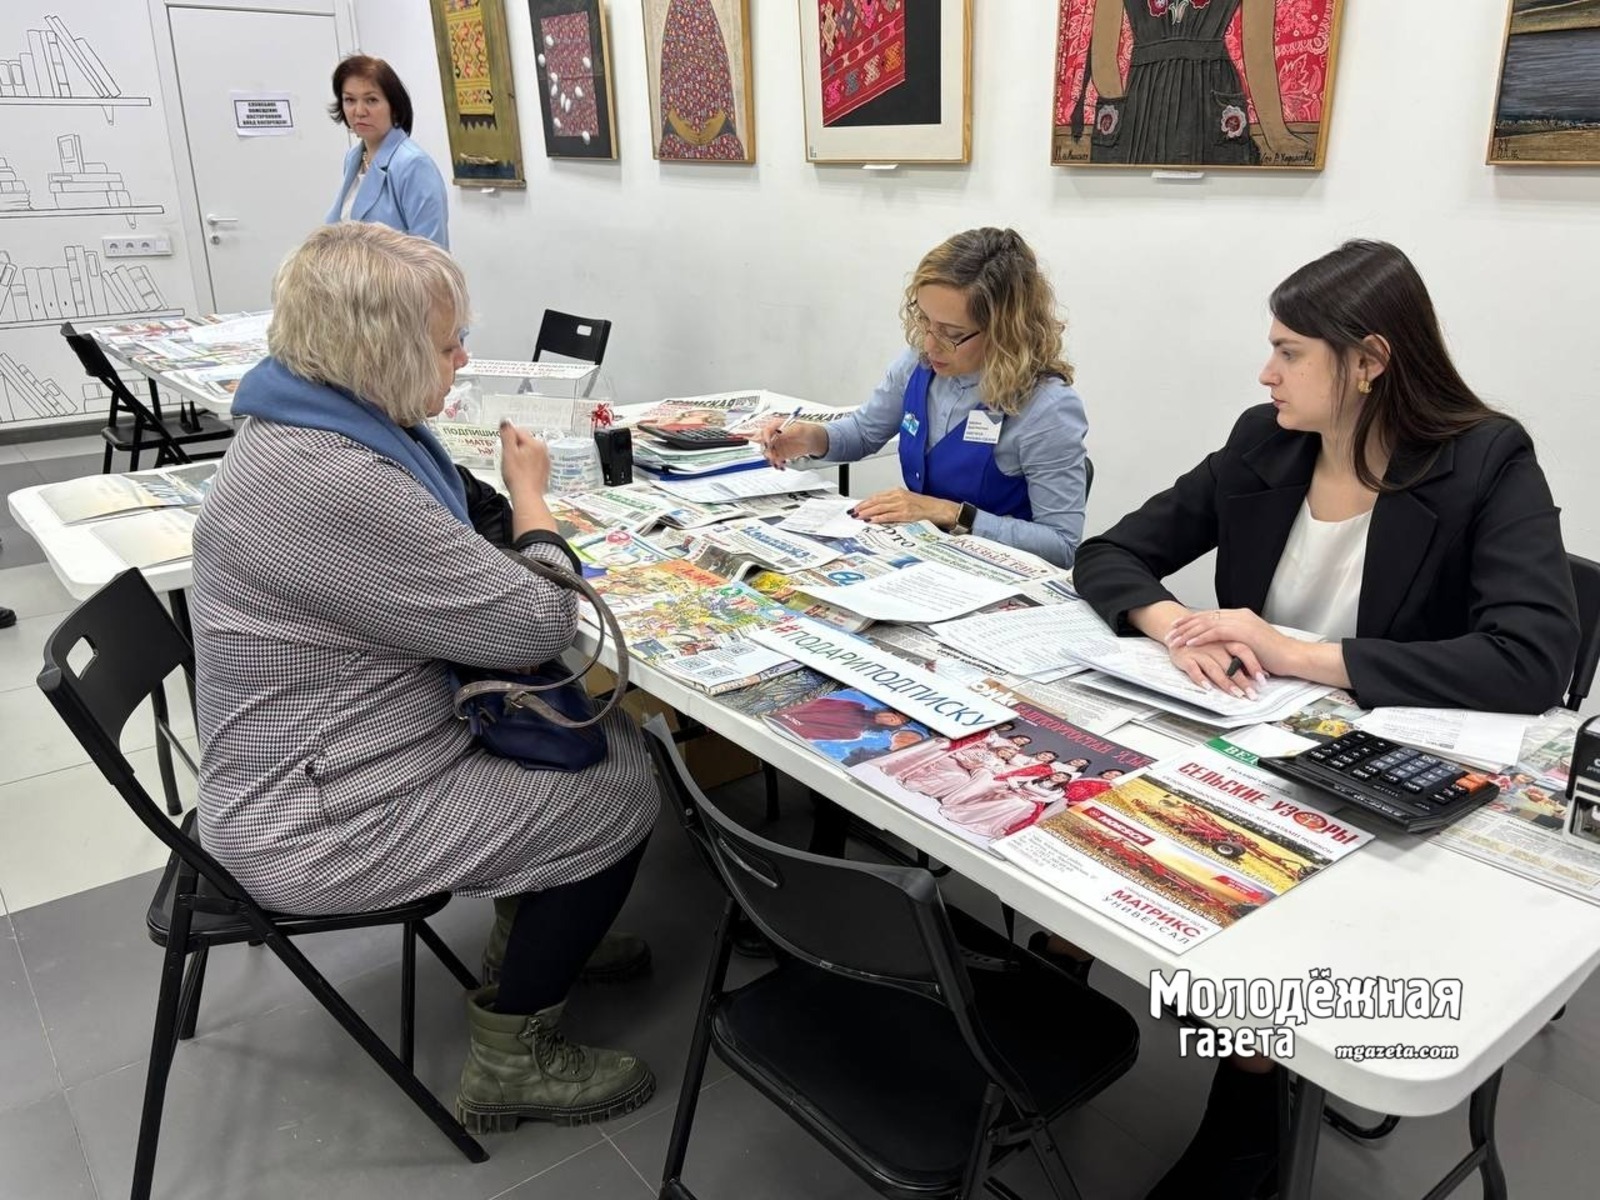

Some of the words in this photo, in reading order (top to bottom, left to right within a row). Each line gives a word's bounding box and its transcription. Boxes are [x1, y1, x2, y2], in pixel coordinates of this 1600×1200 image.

[771, 624, 996, 728] #ПОДАРИПОДПИСКУ
[1178, 762, 1270, 805] СЕЛЬСКИЕ
[1098, 815, 1150, 842] HORSCH
[1102, 895, 1190, 945] УНИВЕРСАЛ
[1111, 889, 1201, 937] МАТРИКС
